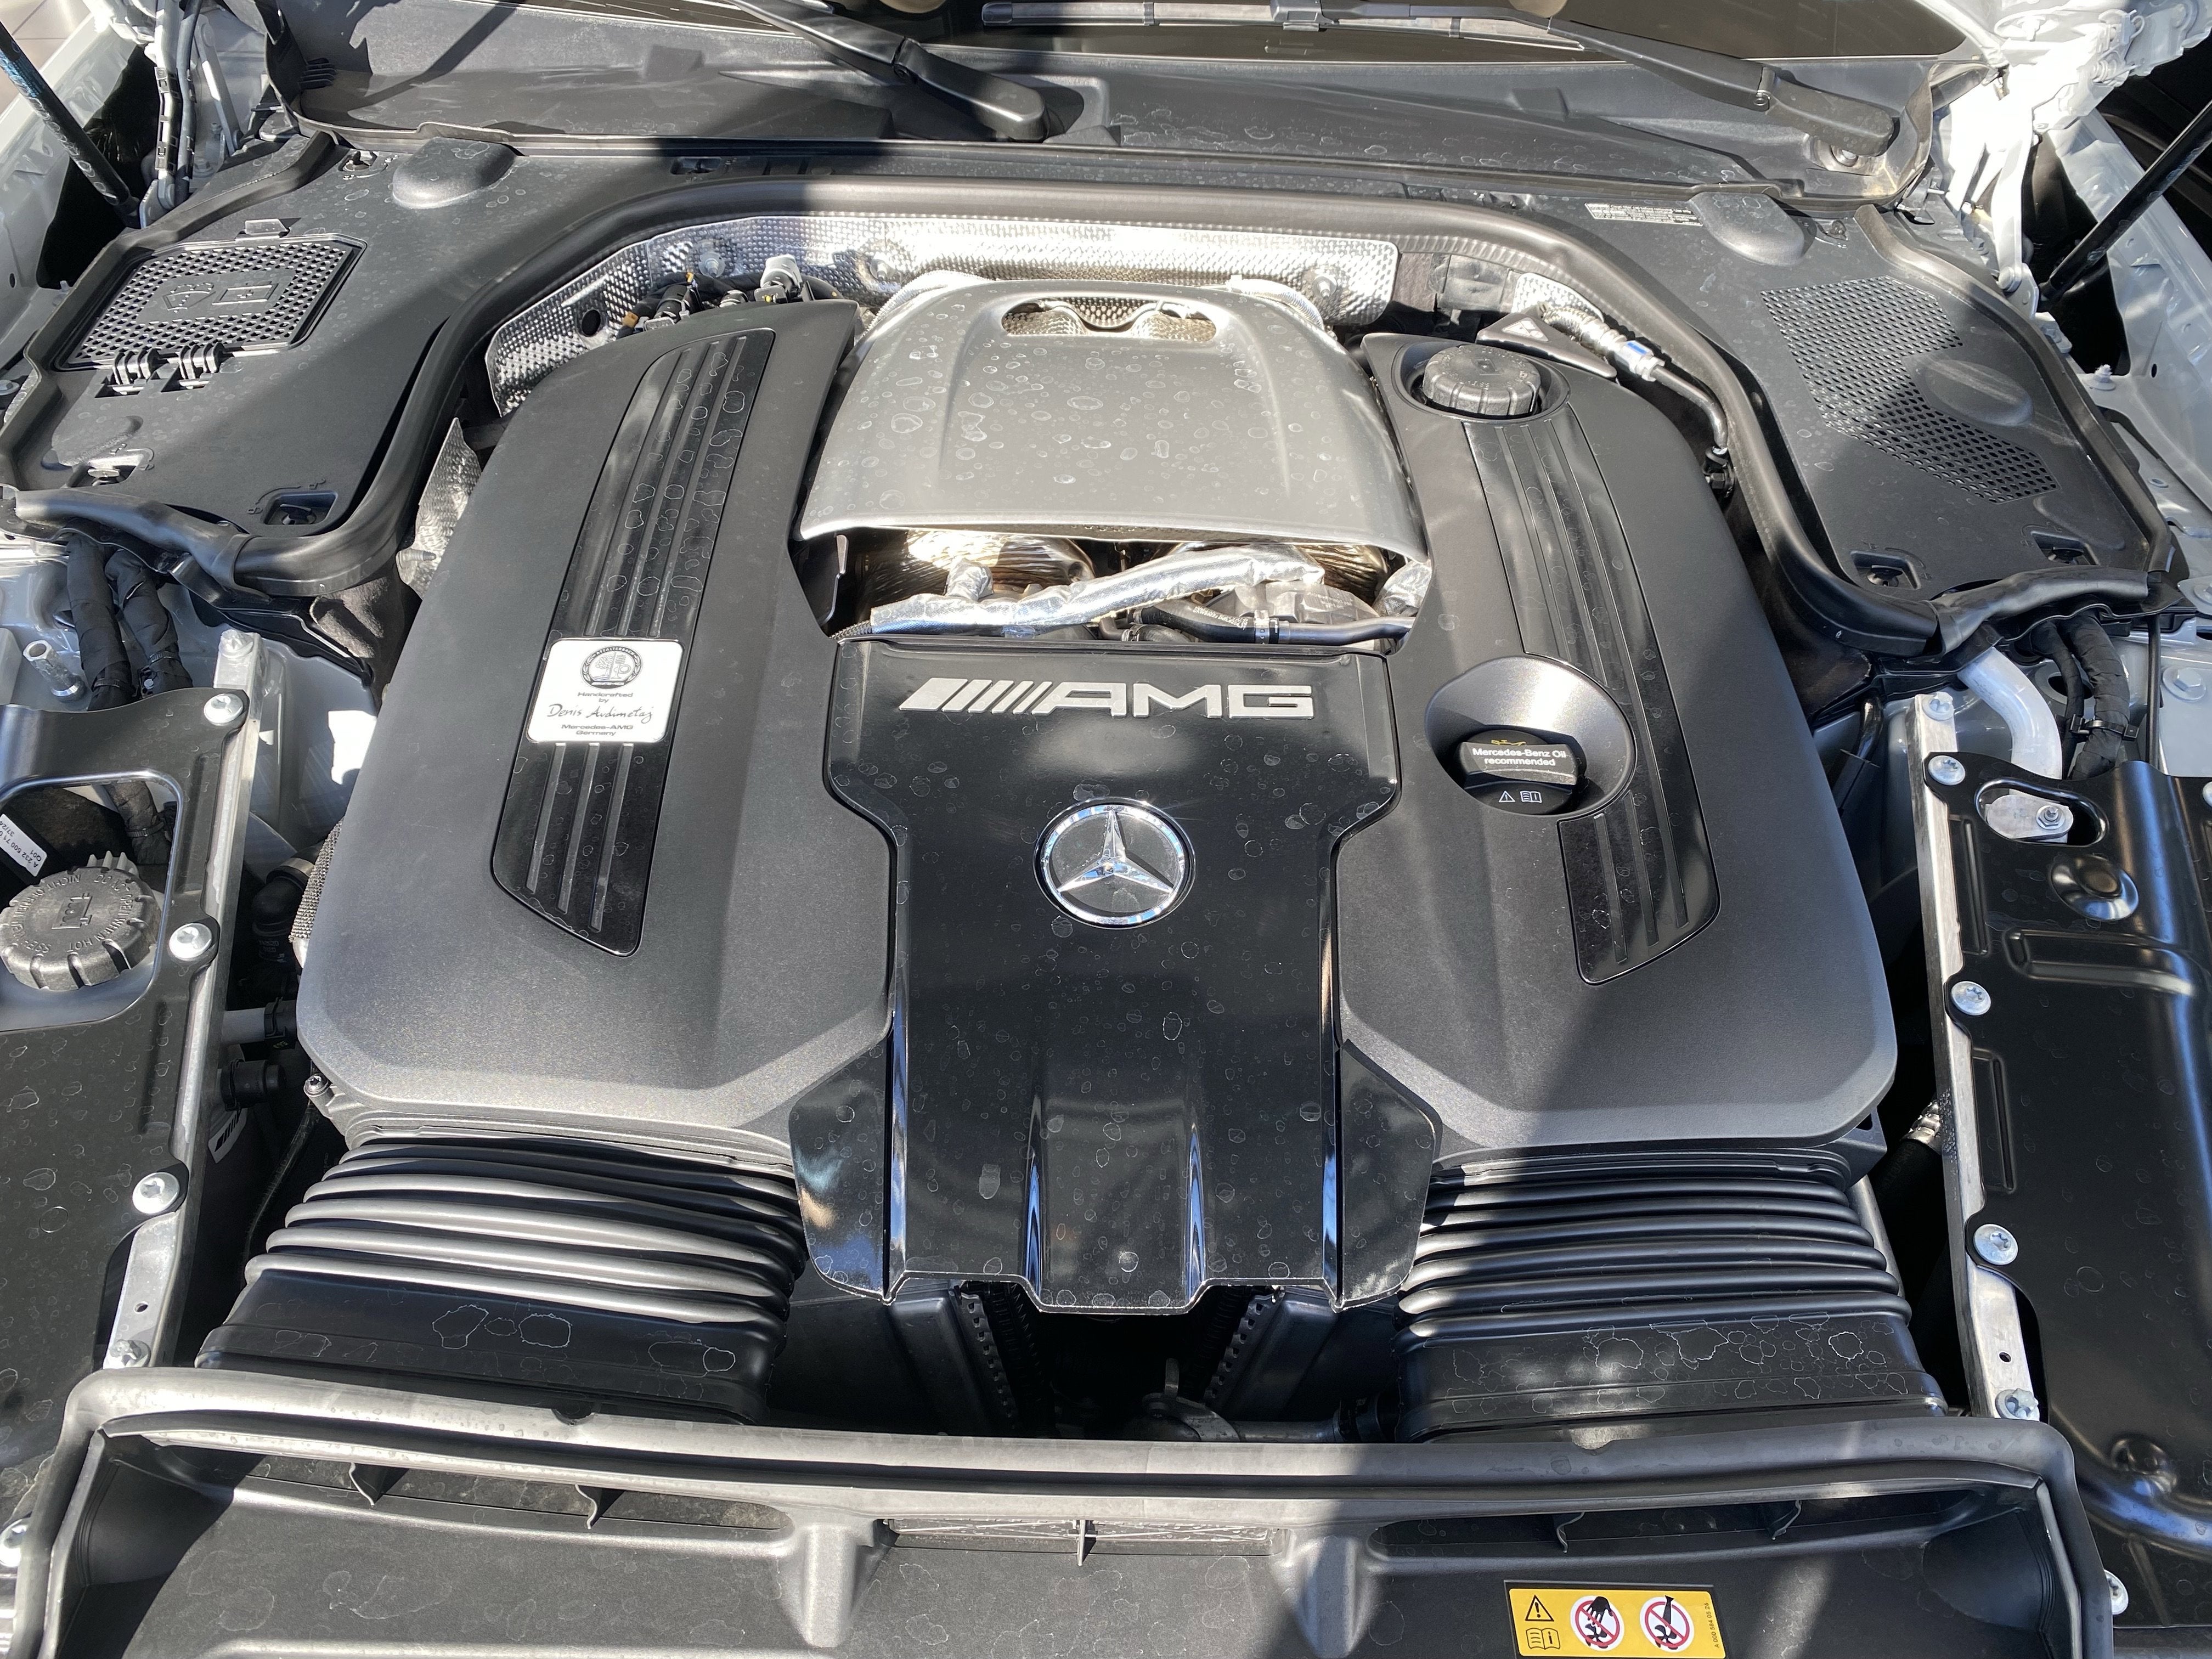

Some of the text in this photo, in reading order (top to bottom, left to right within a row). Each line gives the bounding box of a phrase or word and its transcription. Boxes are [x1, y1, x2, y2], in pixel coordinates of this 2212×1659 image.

[596, 647, 635, 656] AFFALTERBACH
[1032, 681, 1314, 719] AMG
[547, 703, 583, 717] Denis
[1472, 748, 1567, 758] Mercedes-Benz Oil
[3, 835, 11, 844] 71
[10, 842, 22, 854] 500
[21, 852, 33, 864] 232
[30, 849, 42, 861] Q01
[47, 874, 81, 891] NICHT
[93, 874, 112, 884] DO
[118, 894, 133, 916] OPEN
[93, 918, 127, 942] WHEN
[66, 938, 93, 952] HOT
